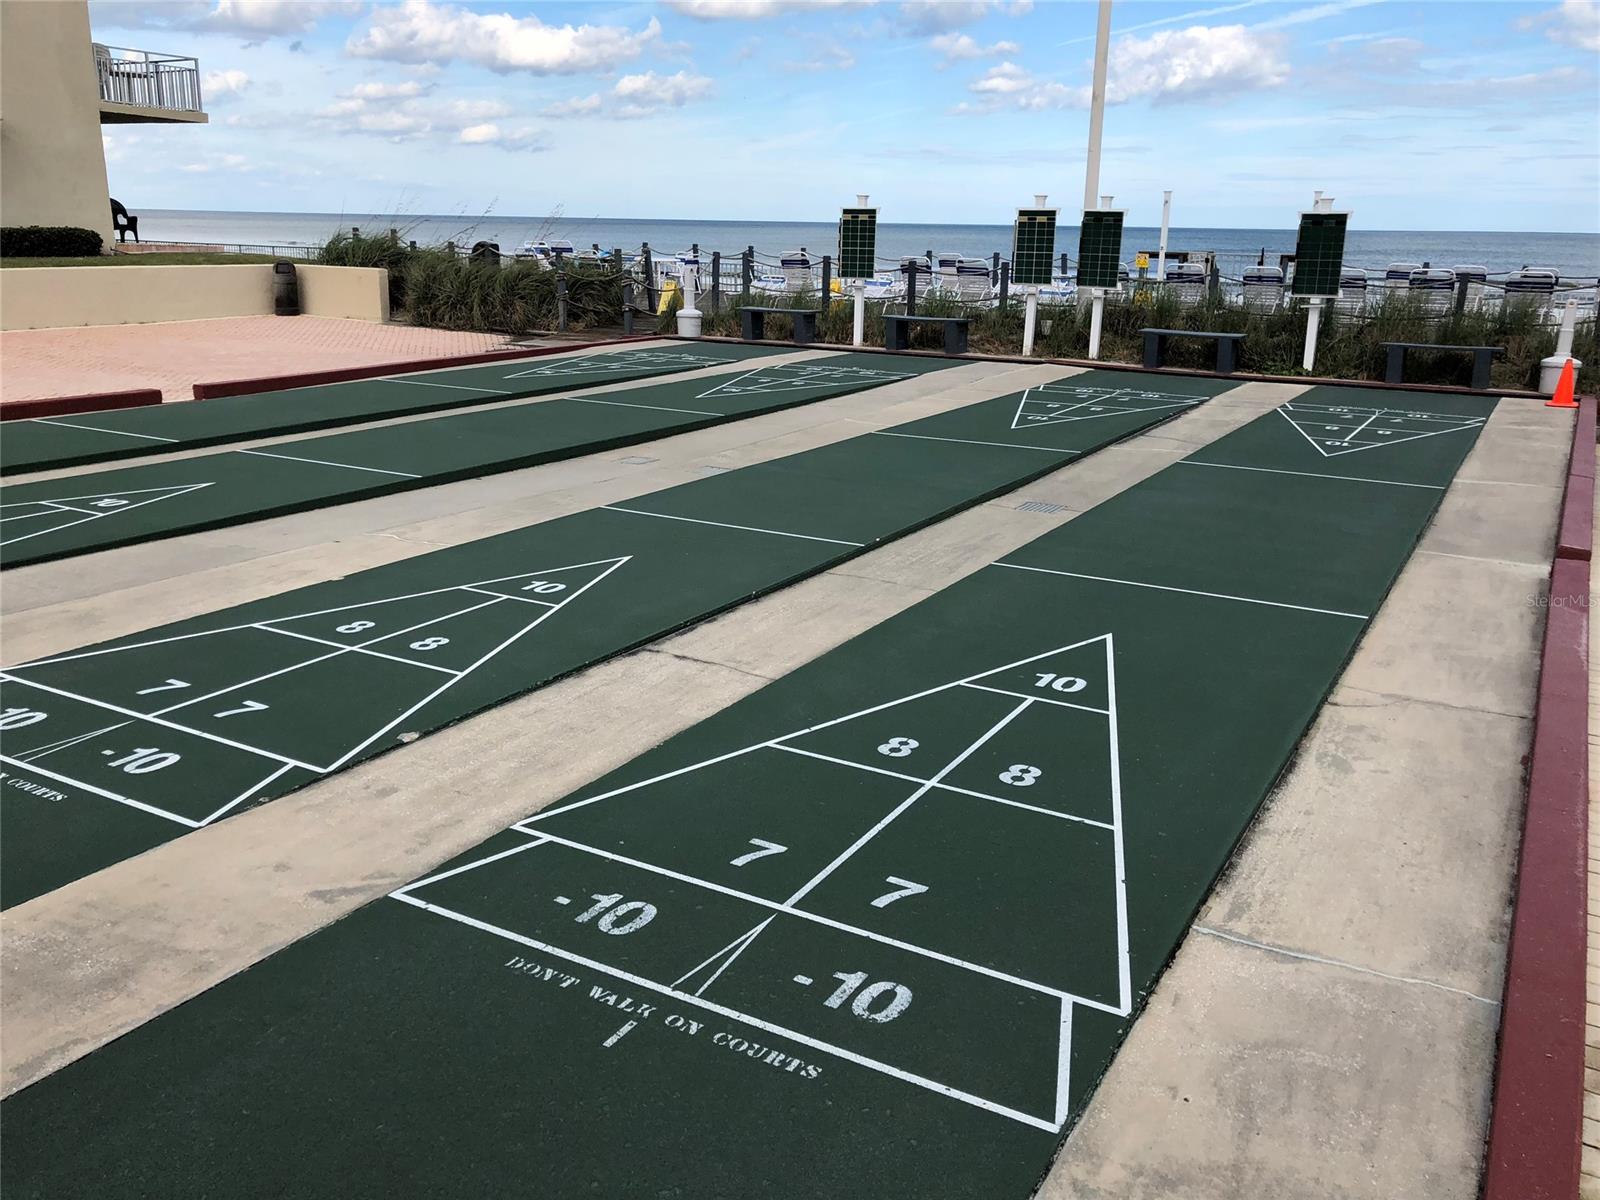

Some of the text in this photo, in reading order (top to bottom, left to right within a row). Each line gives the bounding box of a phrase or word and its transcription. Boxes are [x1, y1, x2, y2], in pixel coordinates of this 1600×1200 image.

[521, 580, 567, 594] 10
[336, 620, 376, 634] 8
[408, 636, 450, 651] 8
[136, 678, 192, 695] 7
[1034, 673, 1088, 693] 10
[213, 699, 269, 718] 7
[877, 737, 920, 758] 8
[100, 747, 181, 774] -10
[998, 764, 1042, 787] 8
[6, 777, 68, 803] COURTS
[730, 838, 788, 867] 7
[870, 876, 929, 908] 7
[553, 893, 658, 935] -10
[791, 970, 913, 1024] -10
[505, 956, 823, 1080] DON'T WALK ON COURTS
